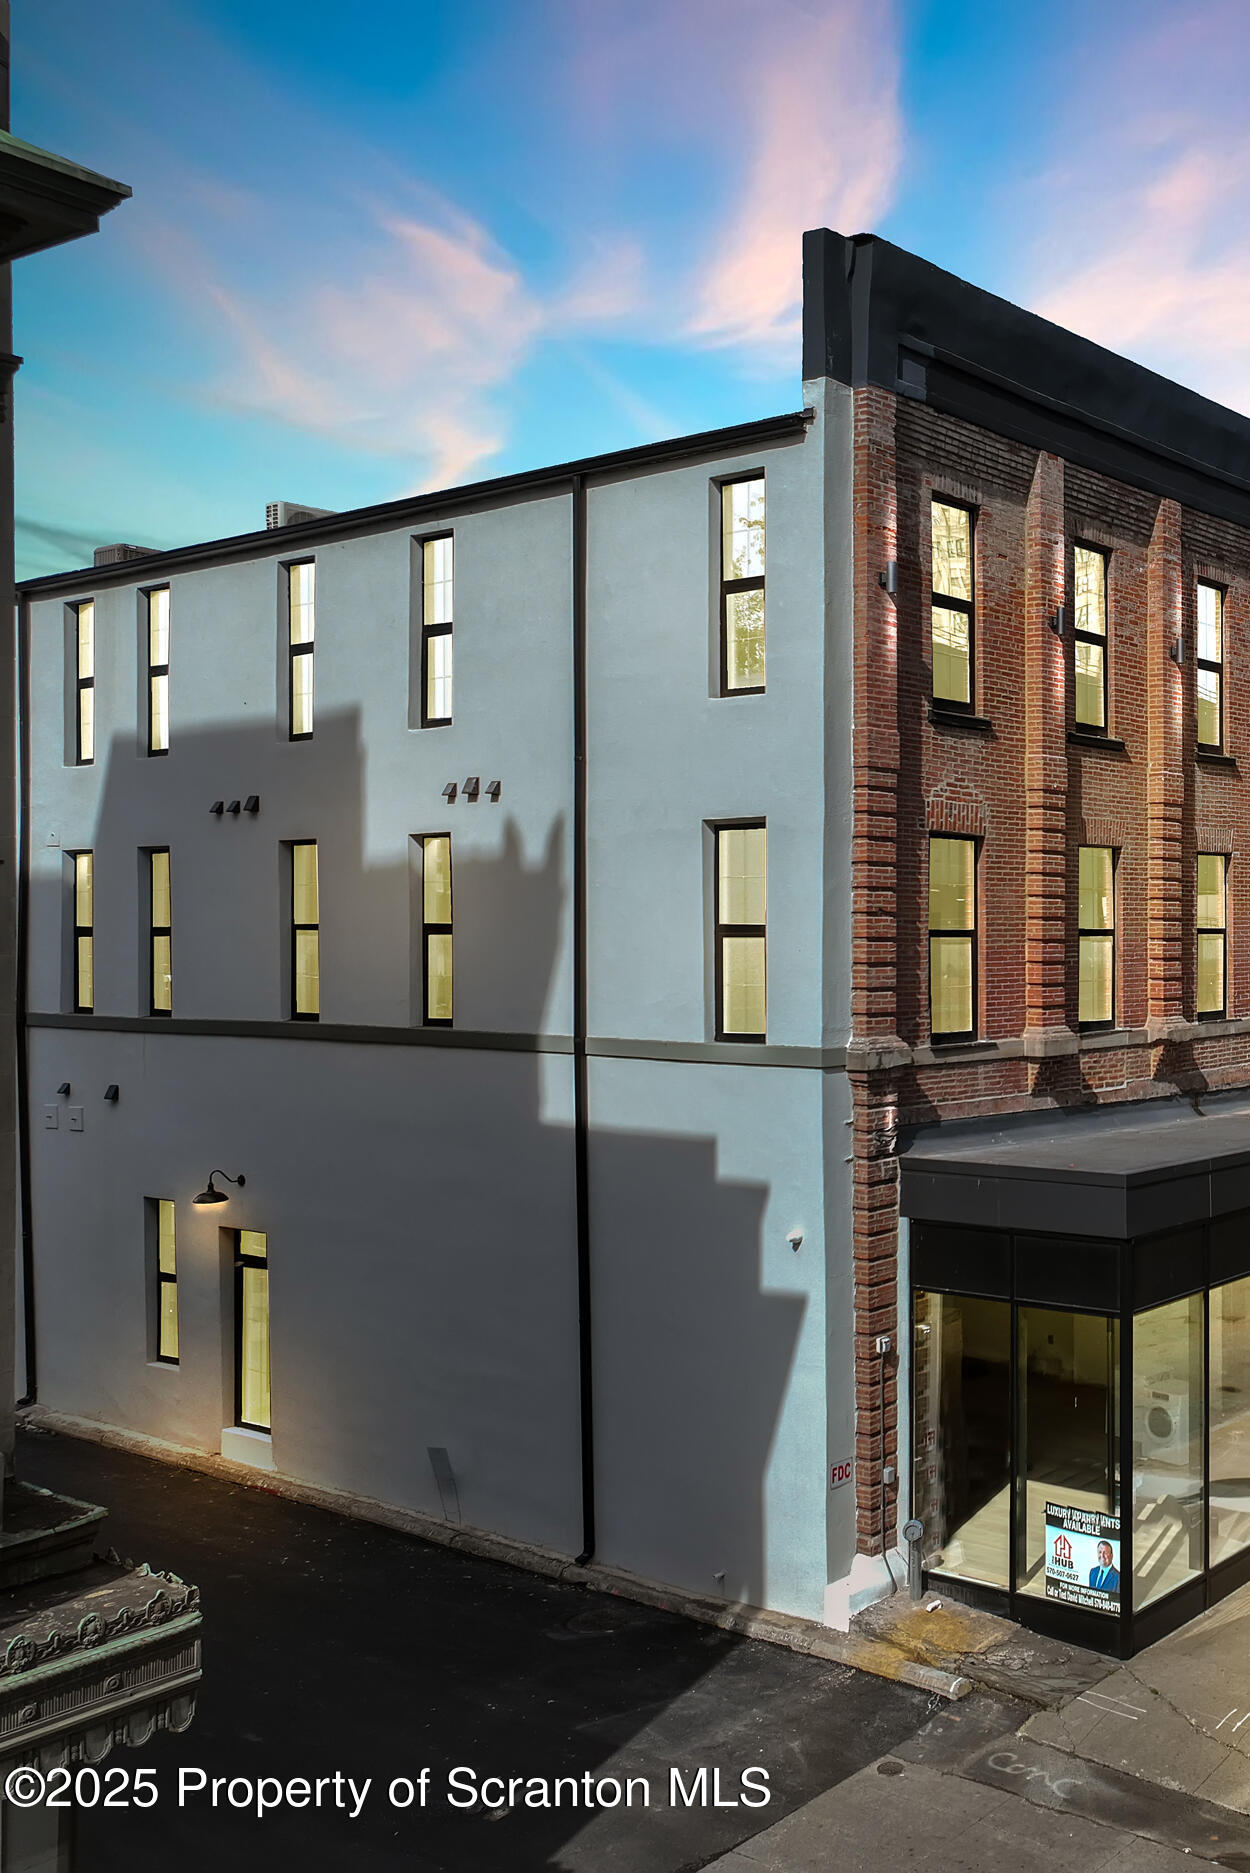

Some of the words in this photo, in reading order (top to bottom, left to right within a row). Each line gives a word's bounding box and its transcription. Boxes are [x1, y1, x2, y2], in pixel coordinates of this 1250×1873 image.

[832, 1462, 851, 1484] FDC
[1046, 1503, 1071, 1520] LUXURY
[1063, 1518, 1101, 1536] AVAILABLE
[1054, 1556, 1074, 1569] HUB
[1060, 1581, 1068, 1590] FOR
[1068, 1583, 1080, 1593] MORE
[1080, 1587, 1109, 1599] INFORMATION
